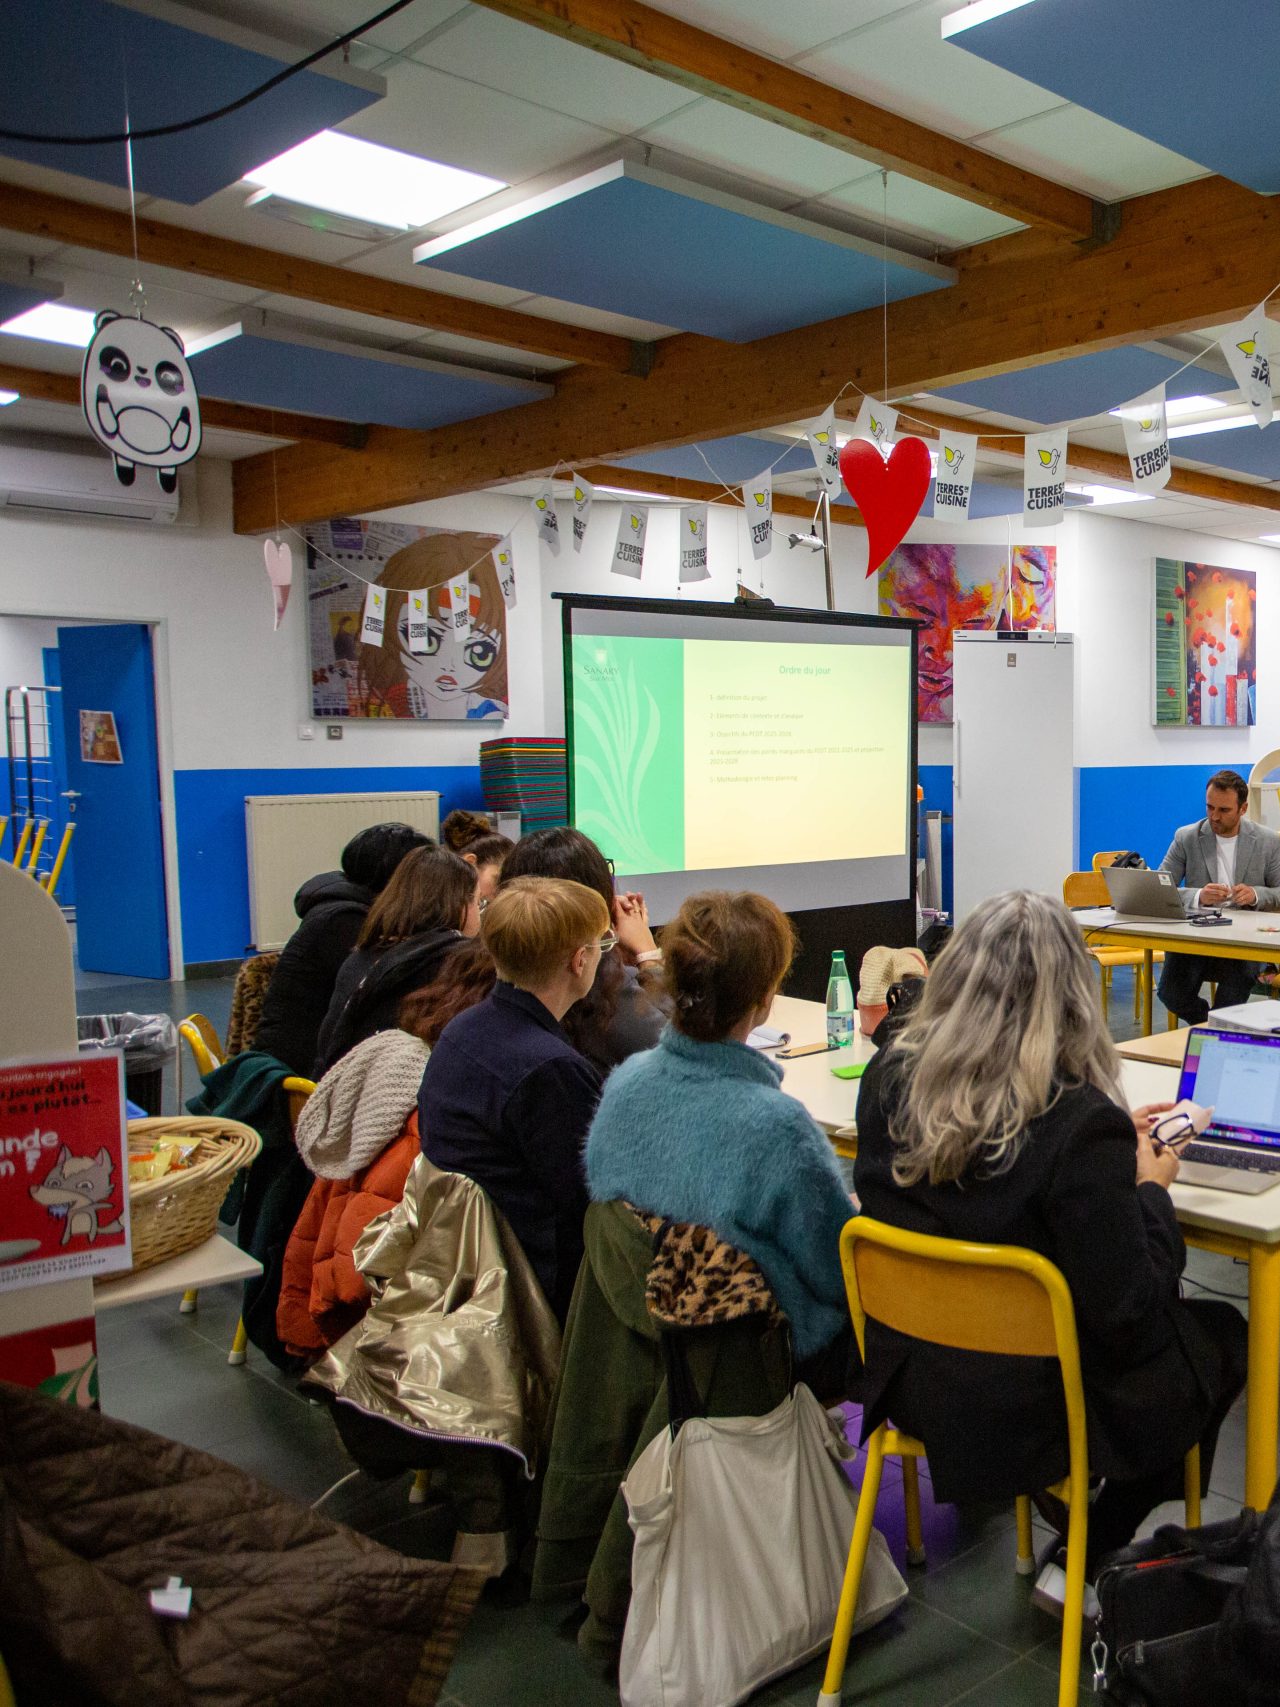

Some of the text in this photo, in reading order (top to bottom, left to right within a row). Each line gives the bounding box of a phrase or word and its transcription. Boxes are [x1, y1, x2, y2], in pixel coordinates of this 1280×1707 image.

[936, 482, 964, 496] TERRES
[1027, 483, 1063, 499] TERRES
[935, 493, 968, 508] CUISINE
[779, 664, 832, 676] Ordre du jour
